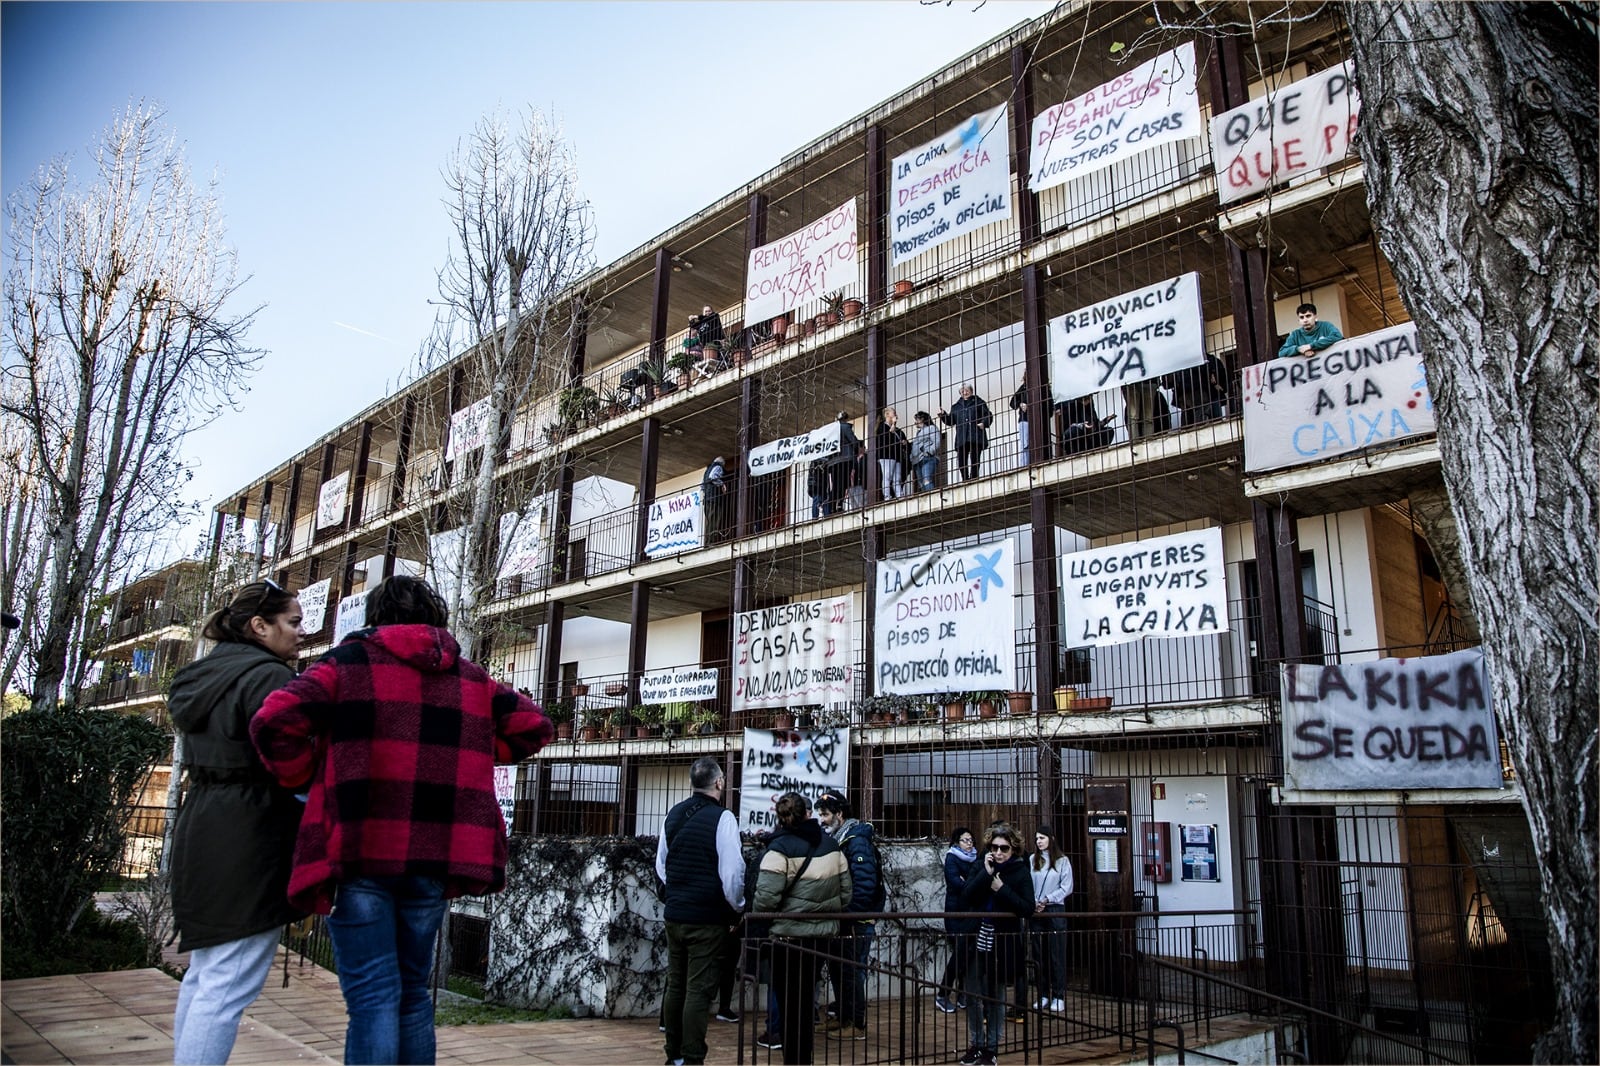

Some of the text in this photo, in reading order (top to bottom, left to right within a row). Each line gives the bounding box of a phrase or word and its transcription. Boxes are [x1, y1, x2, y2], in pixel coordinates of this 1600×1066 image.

[1038, 77, 1162, 146] DESAHUCIOS
[1048, 72, 1134, 126] NO A LOS
[1071, 112, 1126, 149] SON
[1225, 92, 1301, 146] QUE
[898, 143, 947, 180] LA CAIXA
[1037, 112, 1183, 183] NUESTRAS CASAS
[1229, 139, 1307, 187] QUE
[898, 150, 991, 207] DESAHUCIA
[892, 193, 1006, 259] PROTECCIÓN OFICIAL
[896, 185, 961, 232] PISOS DE
[754, 205, 855, 271] RENOVACIÓN
[748, 231, 857, 301] CONTRATOS
[789, 246, 810, 271] DE
[1065, 277, 1181, 334] RENOVACIÓ
[1067, 319, 1177, 358] CONTRACTES
[1104, 317, 1123, 334] DE
[1097, 347, 1146, 387] YA
[1314, 378, 1383, 416] A LA
[1292, 408, 1412, 457] CAIXA
[751, 456, 764, 467] DE
[797, 438, 839, 458] ABUSIUS
[651, 495, 692, 521] LA KIKA
[648, 518, 694, 543] ES QUEDA
[884, 558, 967, 594] LA CAIXA
[1070, 543, 1206, 579] LLOGATERES
[1081, 569, 1208, 598] ENGANYATS
[1116, 592, 1147, 609] PER
[739, 603, 822, 635] DE NUESTRAS
[896, 588, 977, 622] DESNONA
[1083, 600, 1218, 640] LA CAIXA
[750, 627, 815, 664] CASAS
[887, 621, 957, 651] PISOS DE
[643, 674, 672, 687] FUTURO
[784, 666, 808, 690] NOS
[880, 648, 1003, 688] PROTECCIÓ OFICIAL
[1285, 659, 1485, 710] LA KIKA
[642, 689, 656, 699] QUE
[658, 689, 667, 699] NO
[669, 687, 678, 697] TE
[747, 748, 784, 770] A LOS
[1292, 719, 1491, 762] SE QUEDA
[748, 810, 777, 828] REN
